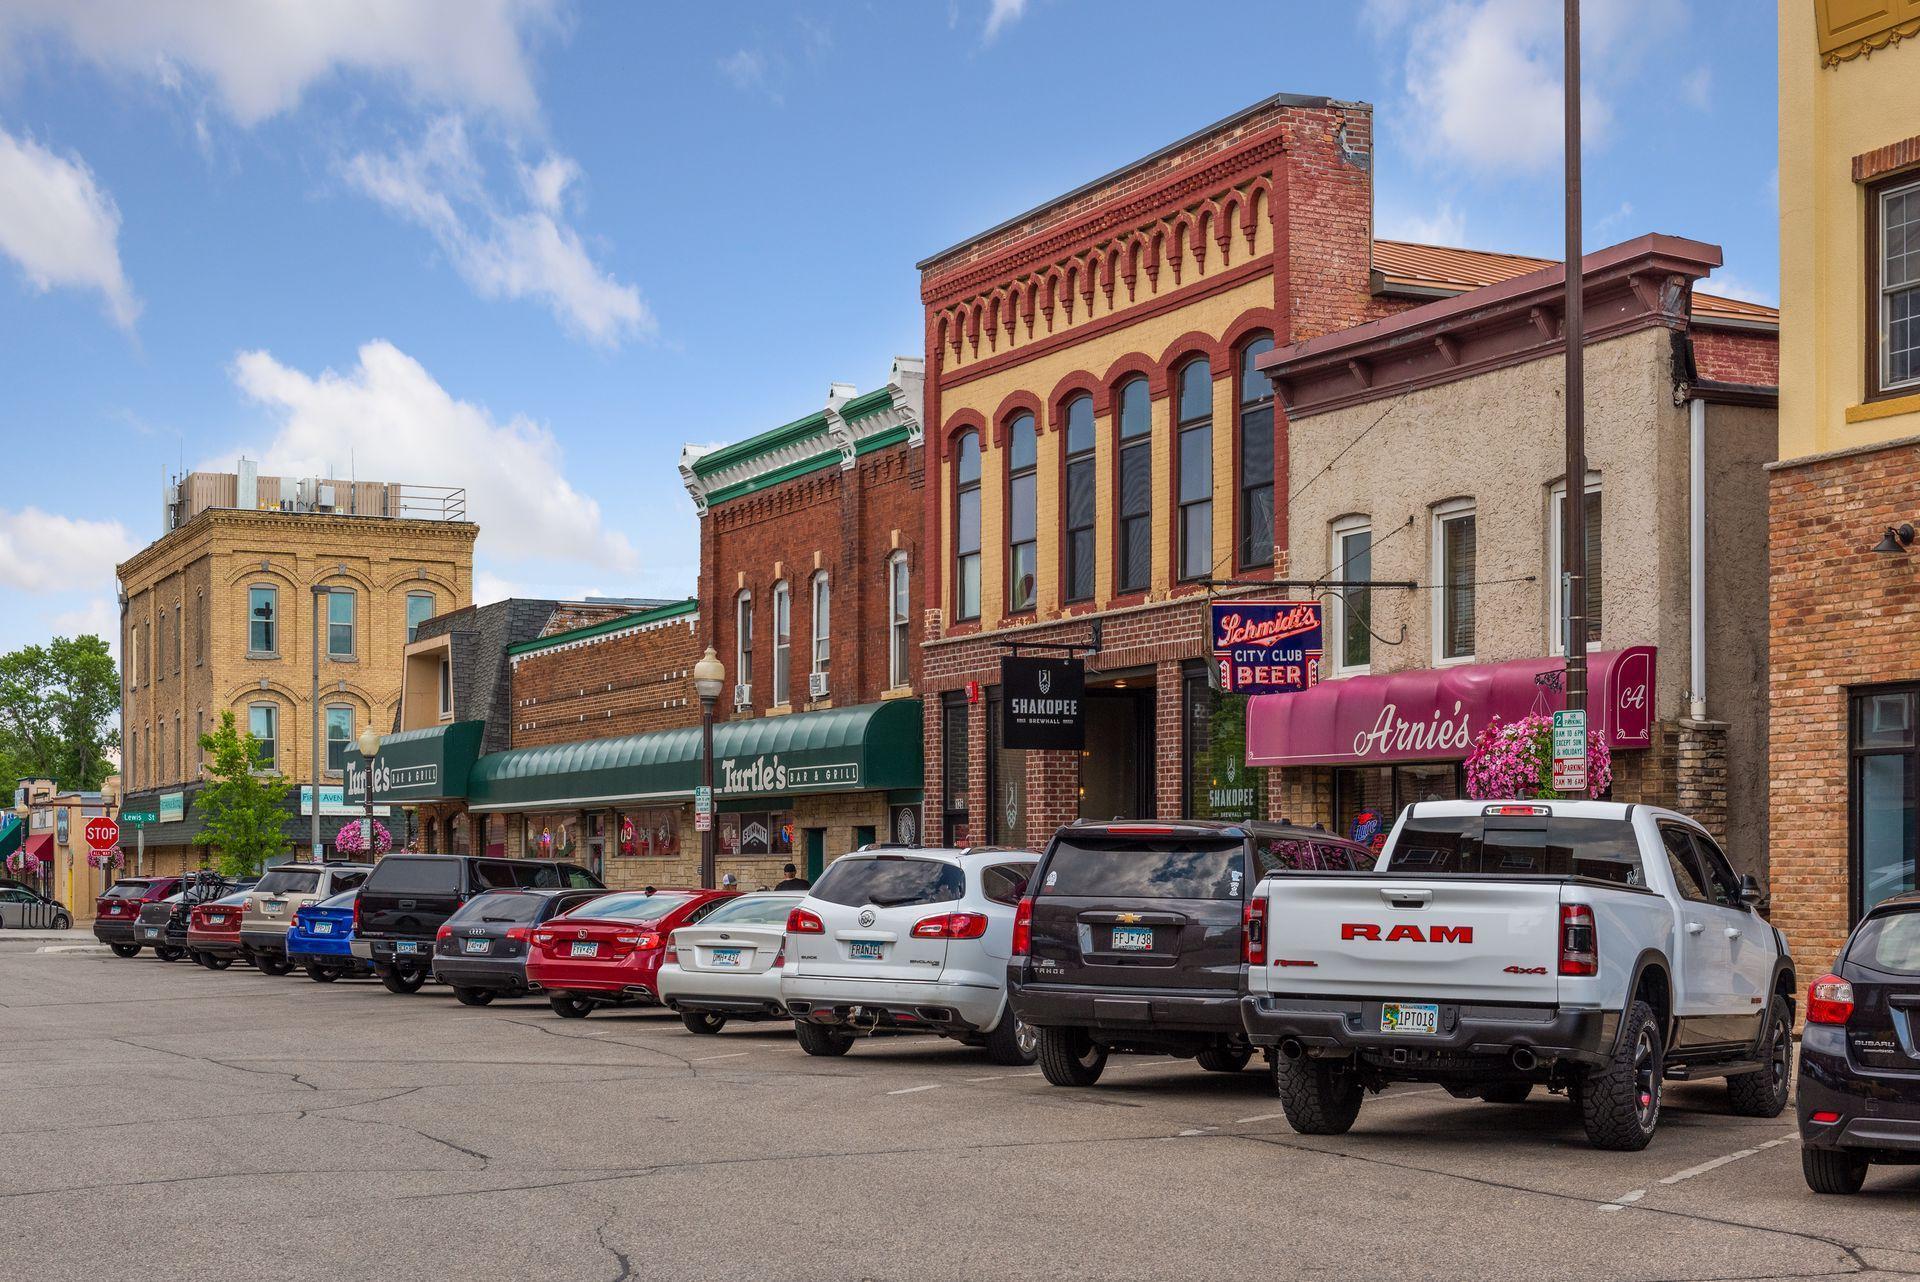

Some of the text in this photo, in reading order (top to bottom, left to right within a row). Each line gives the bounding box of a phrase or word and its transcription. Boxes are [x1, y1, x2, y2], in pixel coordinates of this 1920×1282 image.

[1217, 605, 1320, 647] Schmidt's
[1234, 649, 1302, 662] CITY CLUB
[1237, 666, 1302, 684] BEER
[1620, 684, 1645, 710] A
[1012, 698, 1078, 714] SHAKOPEE
[1354, 700, 1472, 756] Arnie's
[1556, 715, 1562, 727] 2
[347, 757, 390, 795] Turle's
[416, 769, 436, 780] GRILL
[722, 754, 786, 793] Turtle's
[790, 772, 807, 782] BAR
[826, 768, 856, 780] GRILL
[1554, 762, 1563, 774] NO
[1209, 789, 1254, 807] SHAKOPEE
[87, 828, 116, 840] STOP
[744, 825, 767, 840] SUMMIT
[1341, 923, 1473, 944] RAM
[1034, 967, 1065, 975] TAHOE
[1503, 966, 1548, 975] 4x4
[1399, 1010, 1434, 1027] 1PT018
